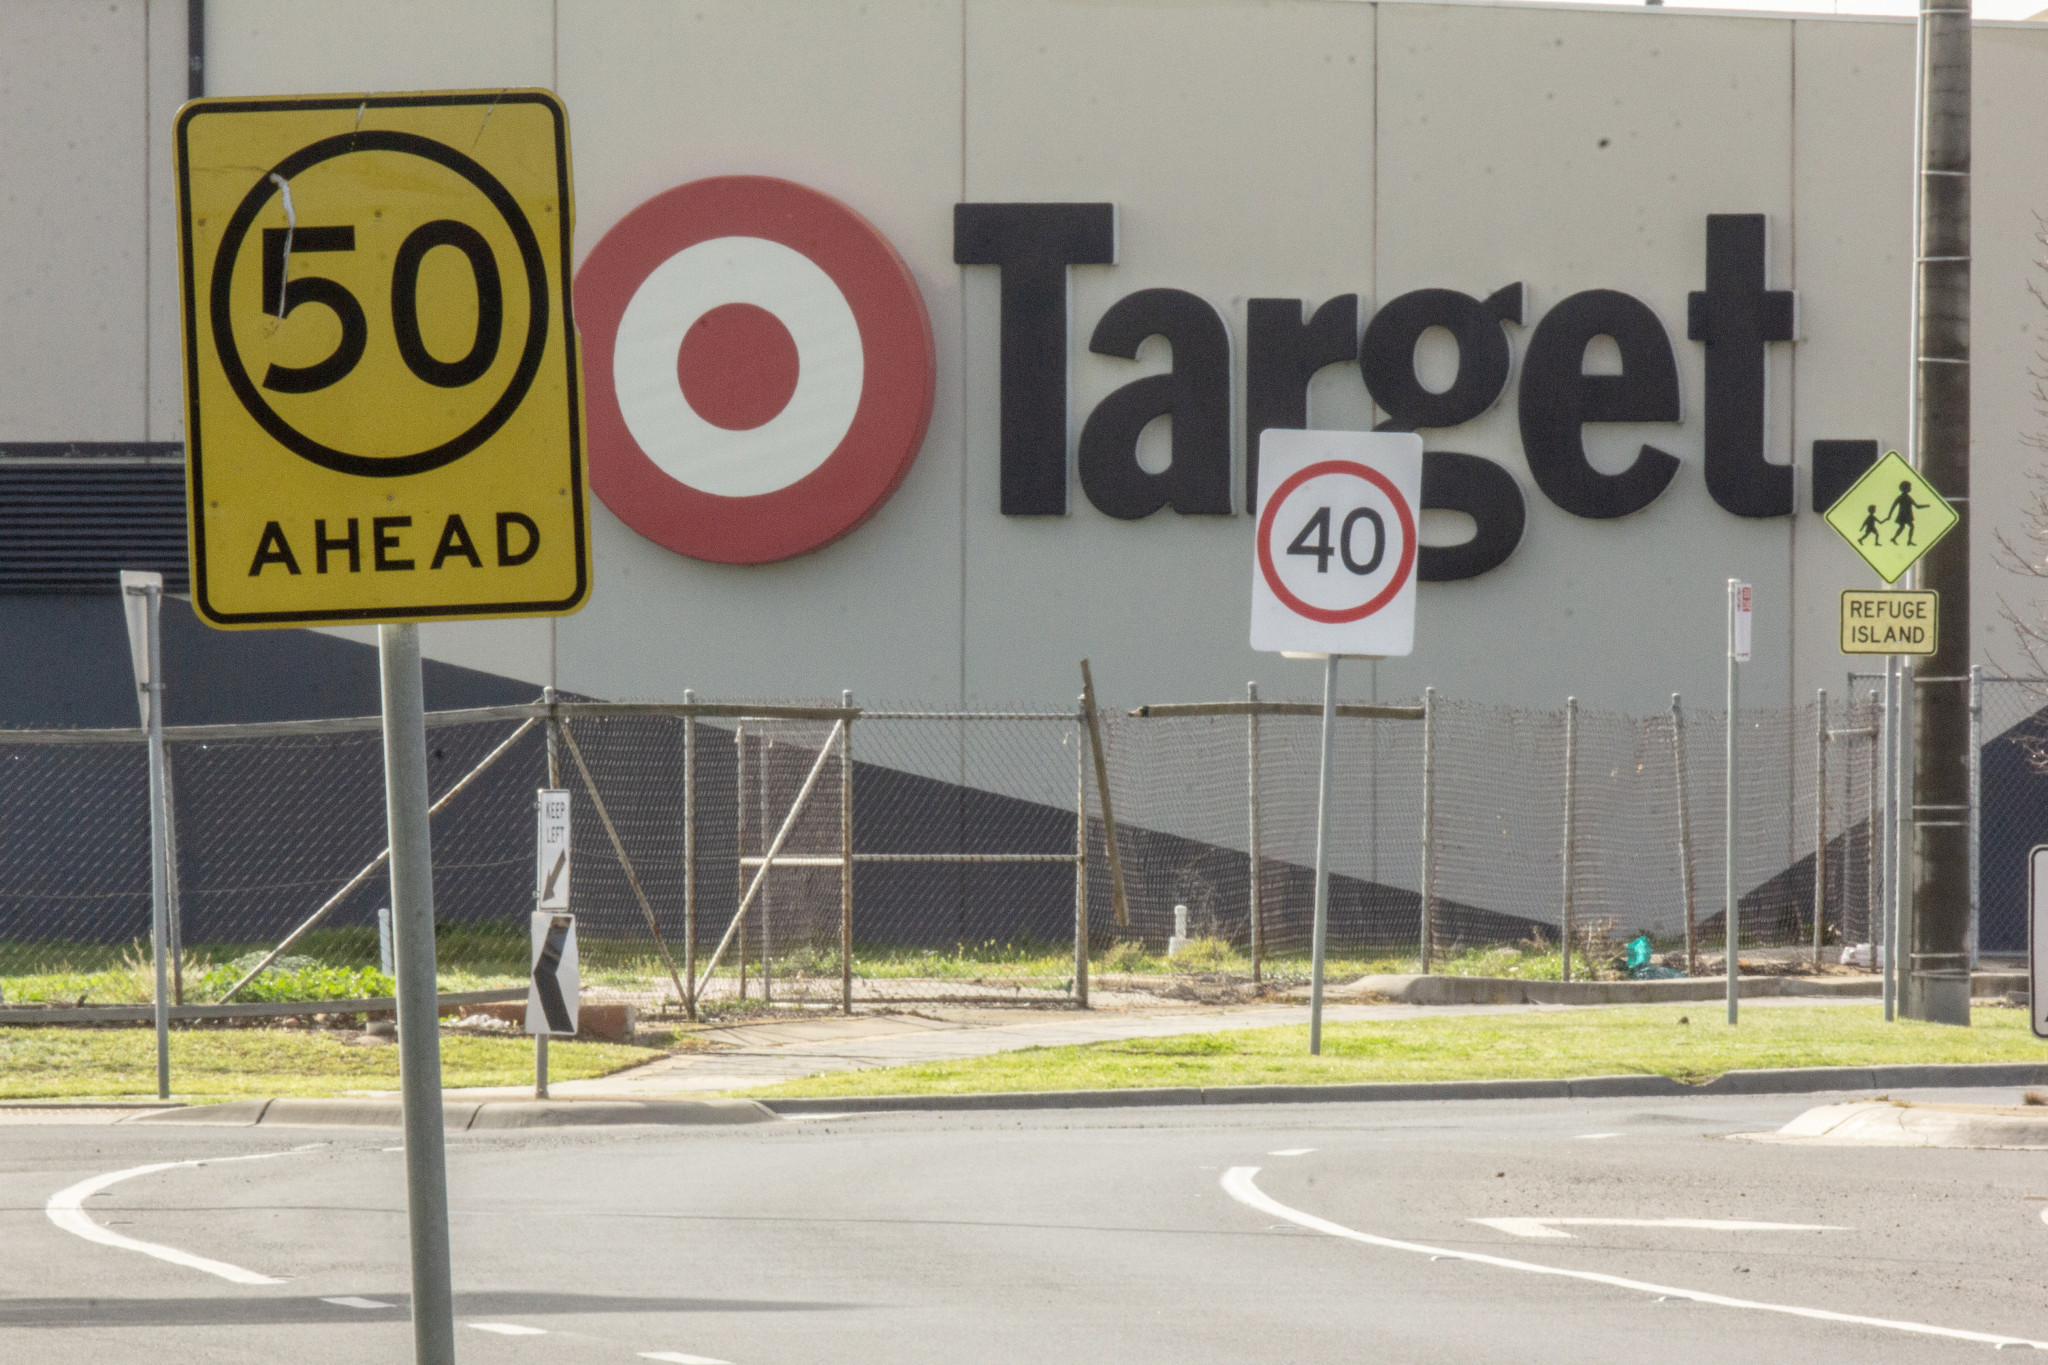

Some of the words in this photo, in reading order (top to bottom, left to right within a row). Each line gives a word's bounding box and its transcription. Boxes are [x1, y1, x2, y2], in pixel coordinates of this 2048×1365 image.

[262, 219, 503, 394] 50
[248, 511, 541, 577] AHEAD
[1286, 506, 1387, 575] 40
[1850, 600, 1928, 619] REFUGE
[1851, 626, 1926, 644] ISLAND
[546, 802, 565, 819] KEEP
[546, 826, 565, 843] LEFT
